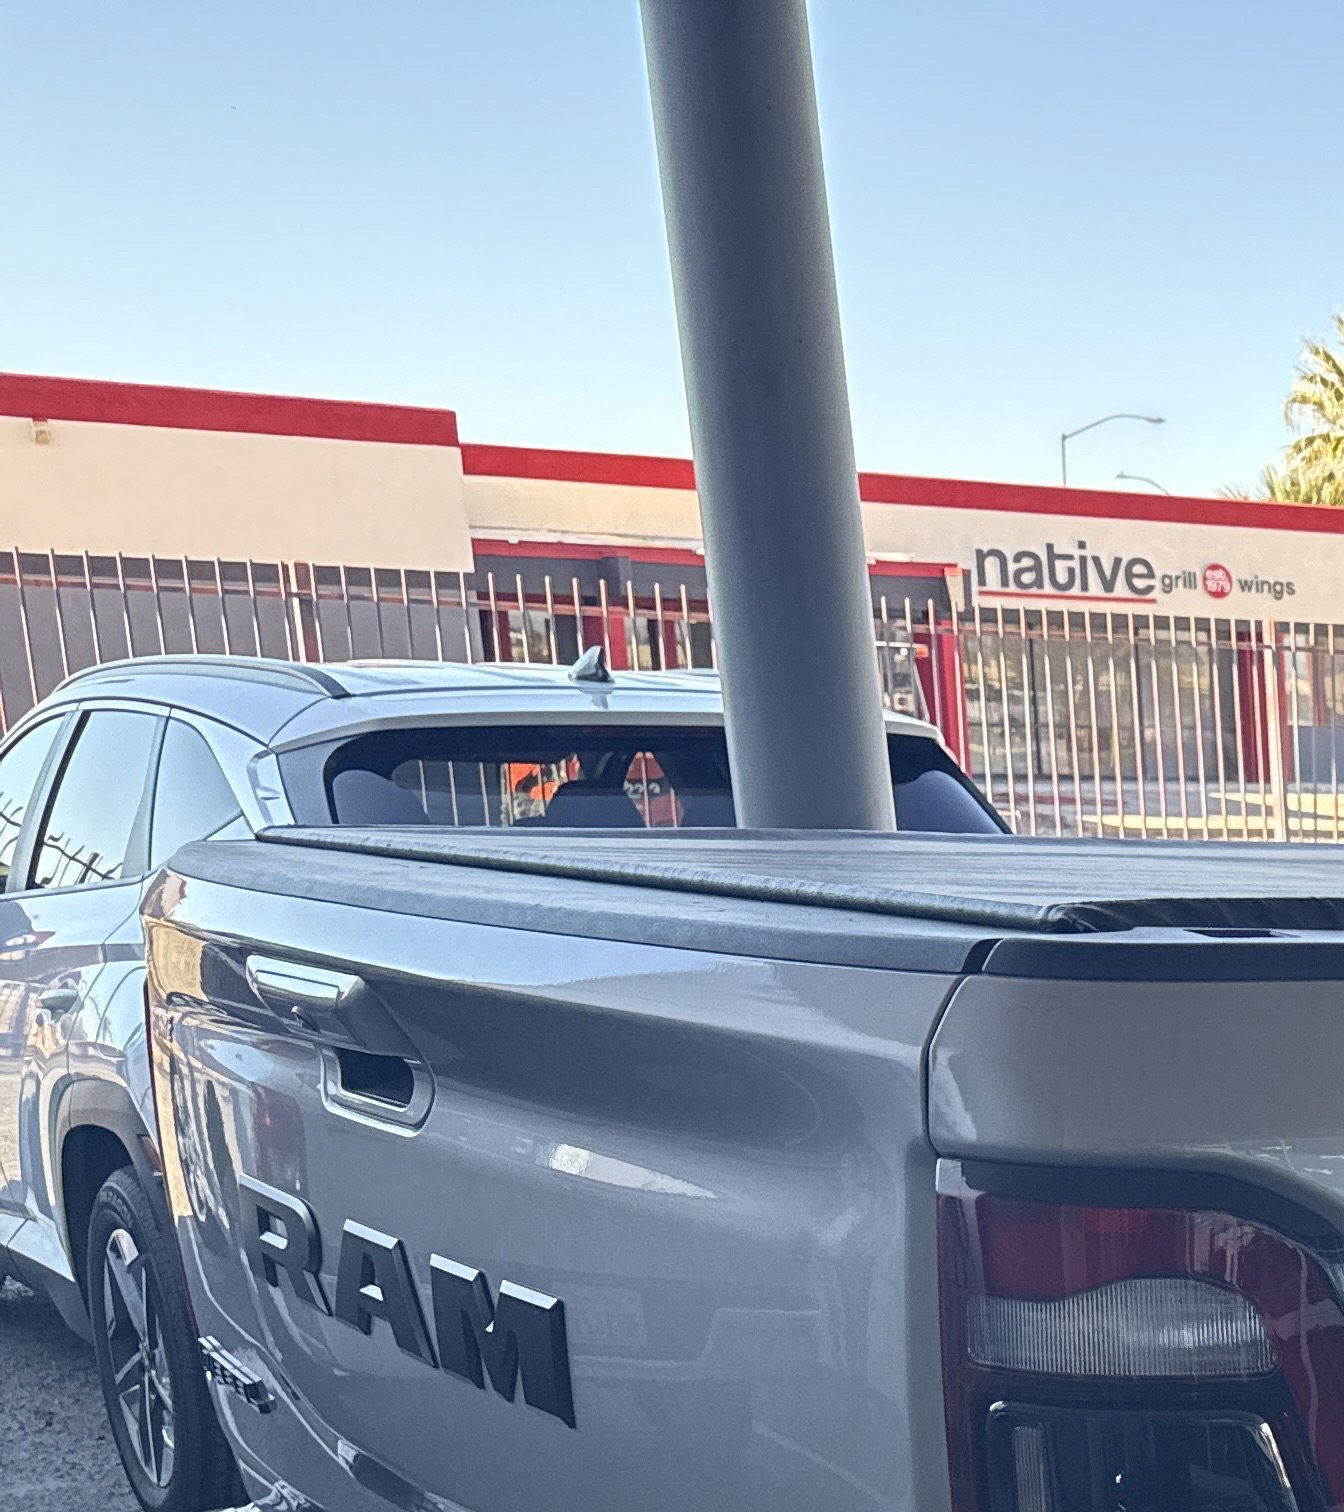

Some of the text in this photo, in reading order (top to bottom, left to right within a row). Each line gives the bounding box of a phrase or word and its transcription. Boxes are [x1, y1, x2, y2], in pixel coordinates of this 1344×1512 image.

[976, 540, 1297, 601] native grill wings
[239, 1172, 577, 1430] RAM
